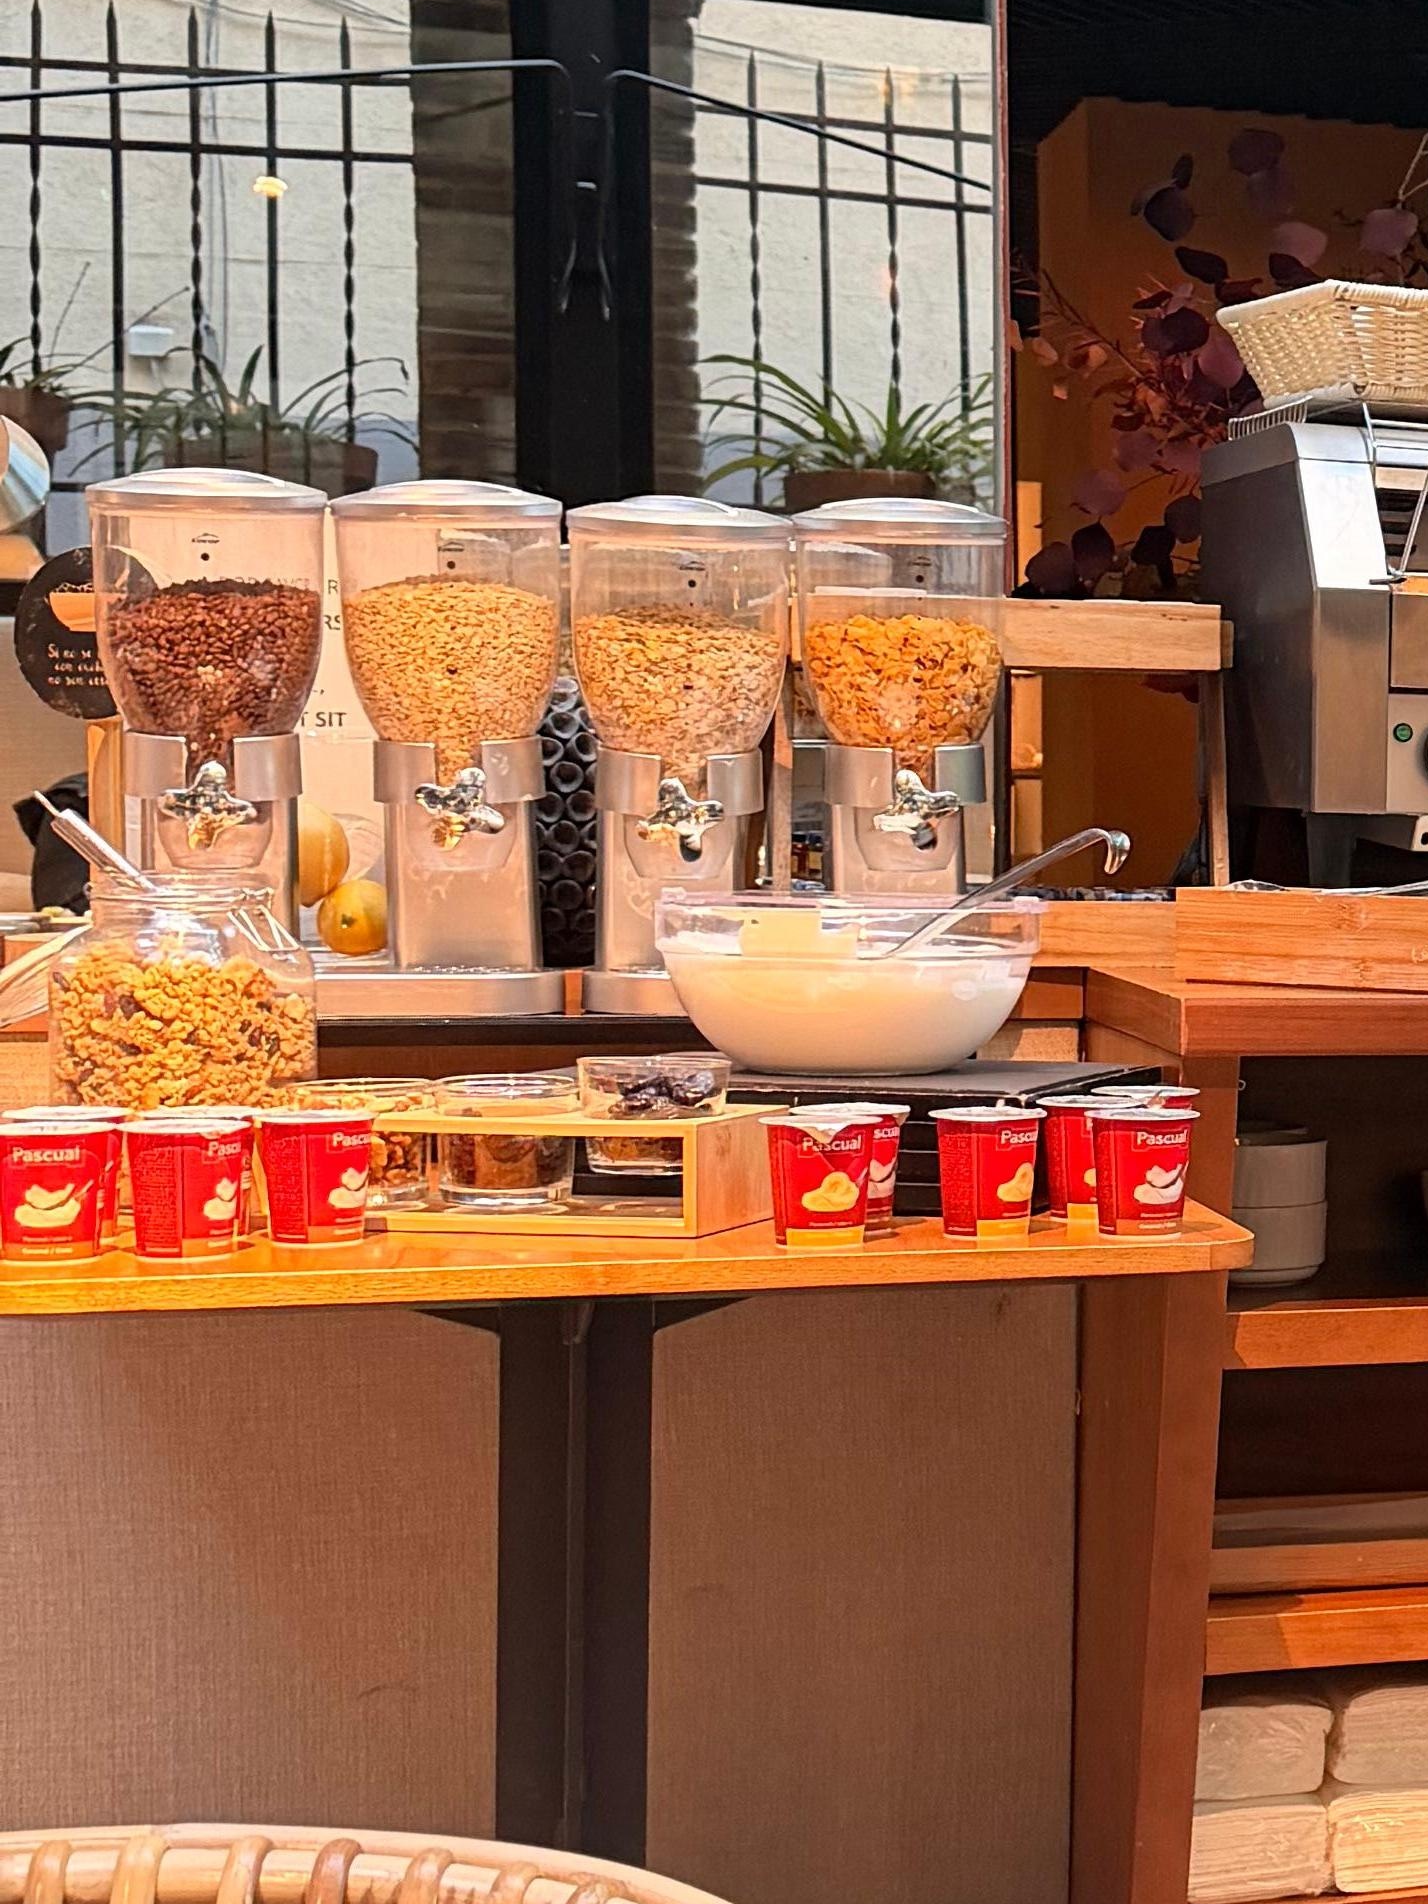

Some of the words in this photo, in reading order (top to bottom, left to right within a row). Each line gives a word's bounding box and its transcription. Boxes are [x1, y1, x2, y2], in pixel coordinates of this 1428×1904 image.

[315, 712, 347, 727] SIT
[802, 1136, 863, 1152] Pascual
[1000, 1129, 1038, 1145] Pascu
[1136, 1130, 1189, 1147] Pascual
[12, 1146, 81, 1164] Pascual
